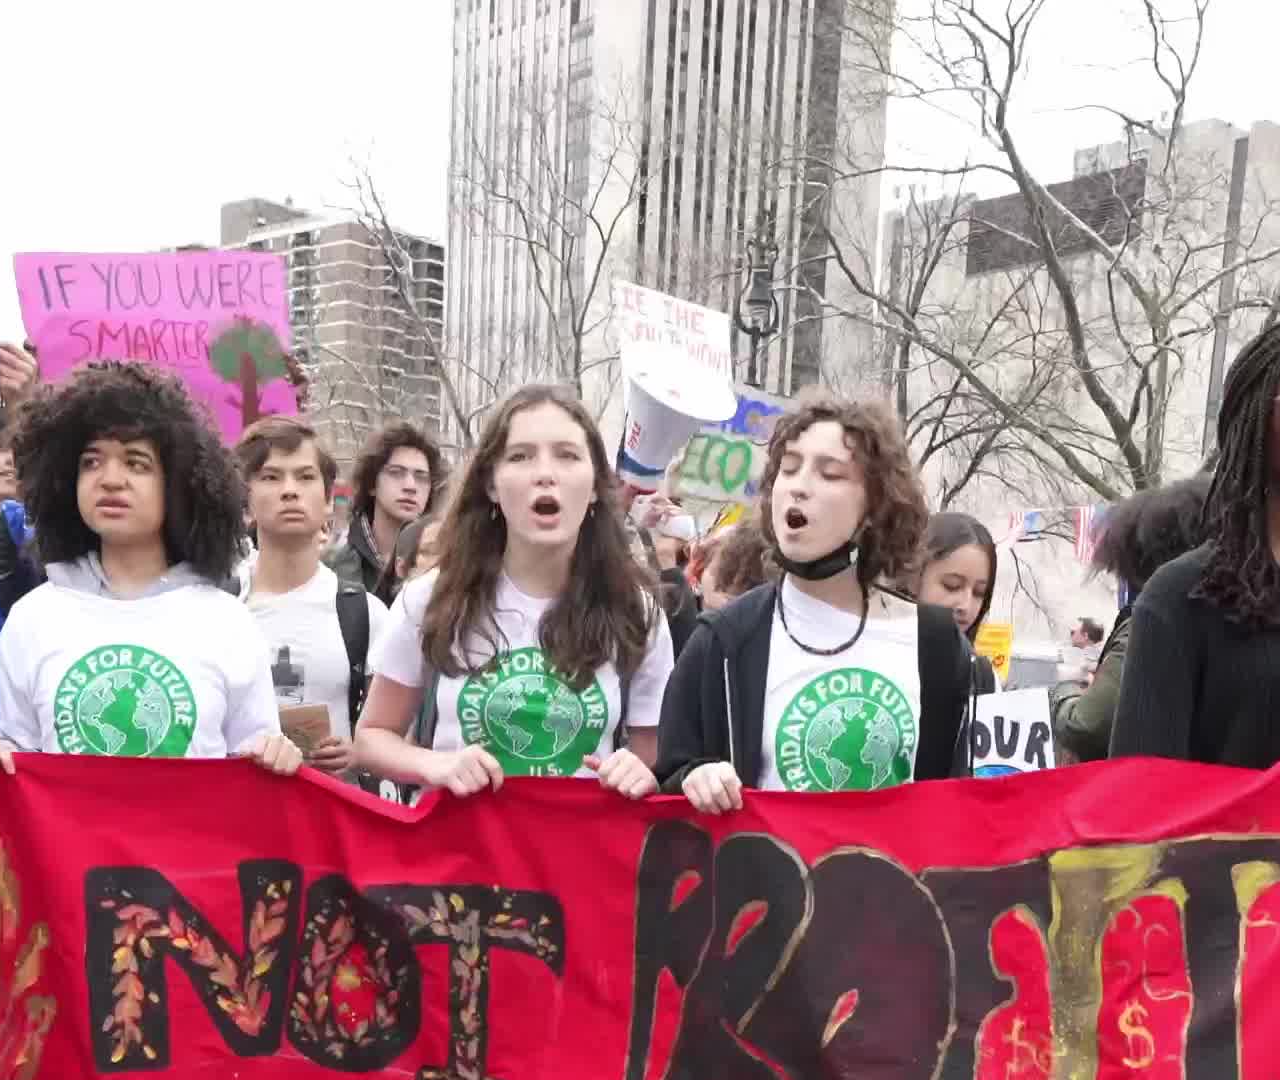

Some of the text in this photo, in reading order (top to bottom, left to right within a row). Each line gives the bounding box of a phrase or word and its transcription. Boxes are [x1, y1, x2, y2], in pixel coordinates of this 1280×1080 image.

[37, 263, 77, 310] IF
[91, 260, 162, 311] YOU
[175, 260, 277, 311] WERE
[70, 318, 211, 367] SMARTER
[684, 433, 752, 492] ECO
[86, 649, 133, 673] FOR
[138, 652, 192, 728] FUTURE
[500, 652, 545, 676] FOR
[781, 697, 817, 791] FRIDAYS
[816, 673, 864, 699] FOR
